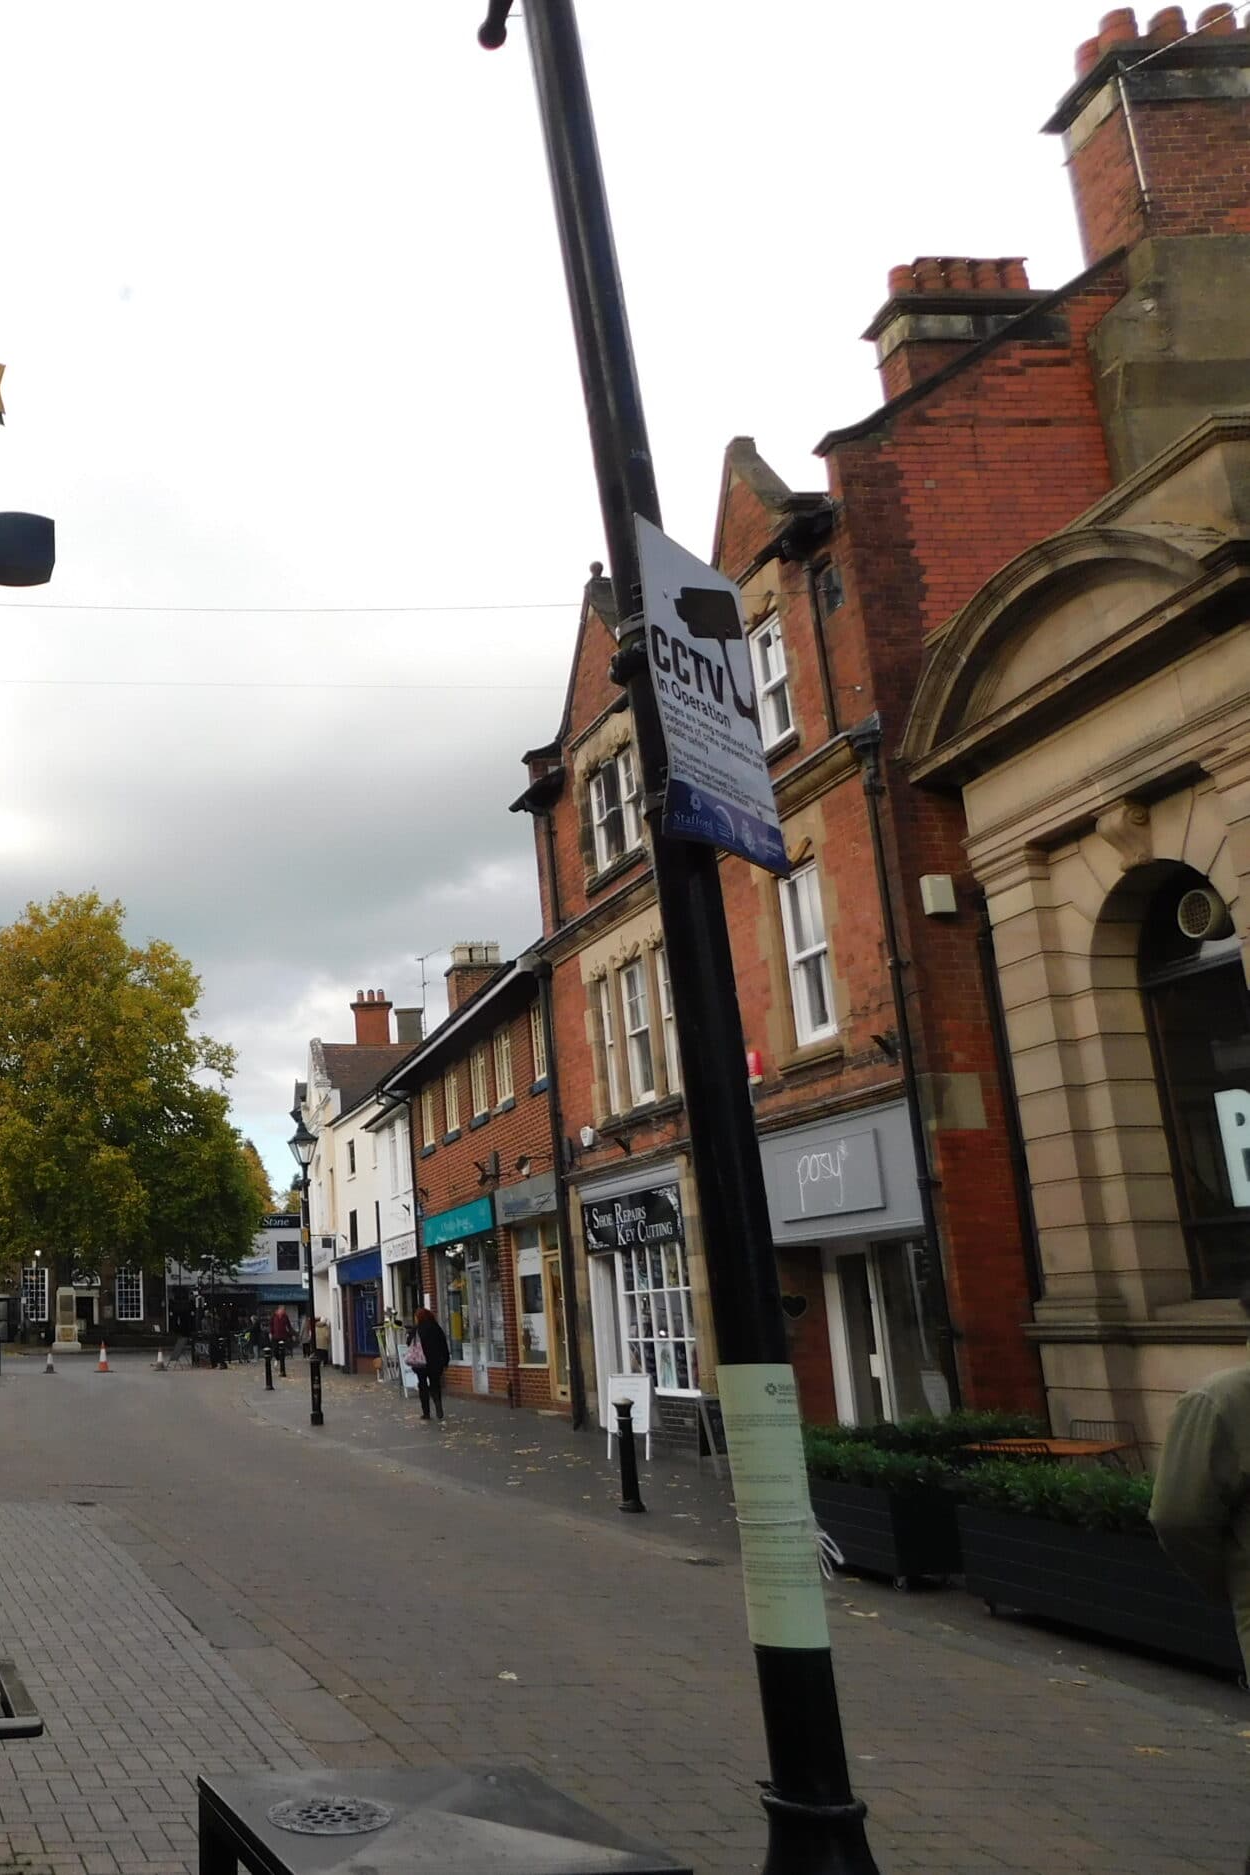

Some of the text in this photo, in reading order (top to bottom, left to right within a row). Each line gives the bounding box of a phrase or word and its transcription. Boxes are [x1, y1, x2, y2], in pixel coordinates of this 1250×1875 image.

[650, 624, 723, 705] CCTV
[656, 671, 731, 728] In Operation
[797, 1150, 844, 1214] posy
[262, 1216, 290, 1227] Stone
[614, 1203, 647, 1224] REPAIRS
[616, 1220, 673, 1246] KEY CUTTING
